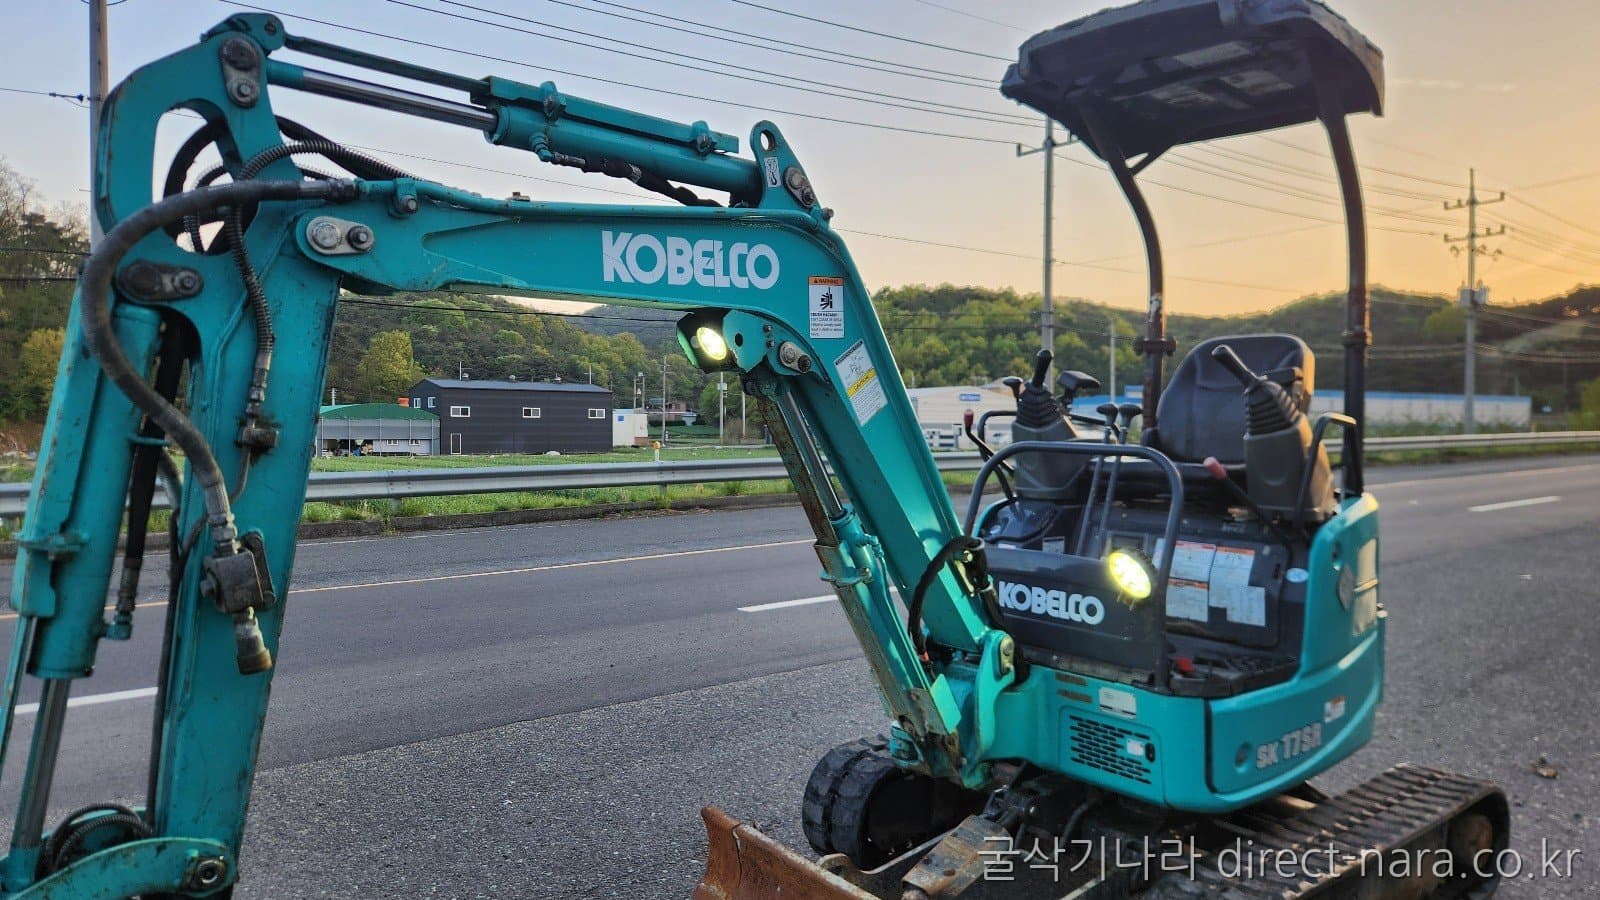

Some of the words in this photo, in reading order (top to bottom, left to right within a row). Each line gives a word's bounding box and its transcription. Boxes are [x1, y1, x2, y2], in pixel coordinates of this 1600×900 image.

[602, 230, 780, 290] KOBELCO
[998, 580, 1106, 625] KOBELCO
[1256, 742, 1279, 769] SK
